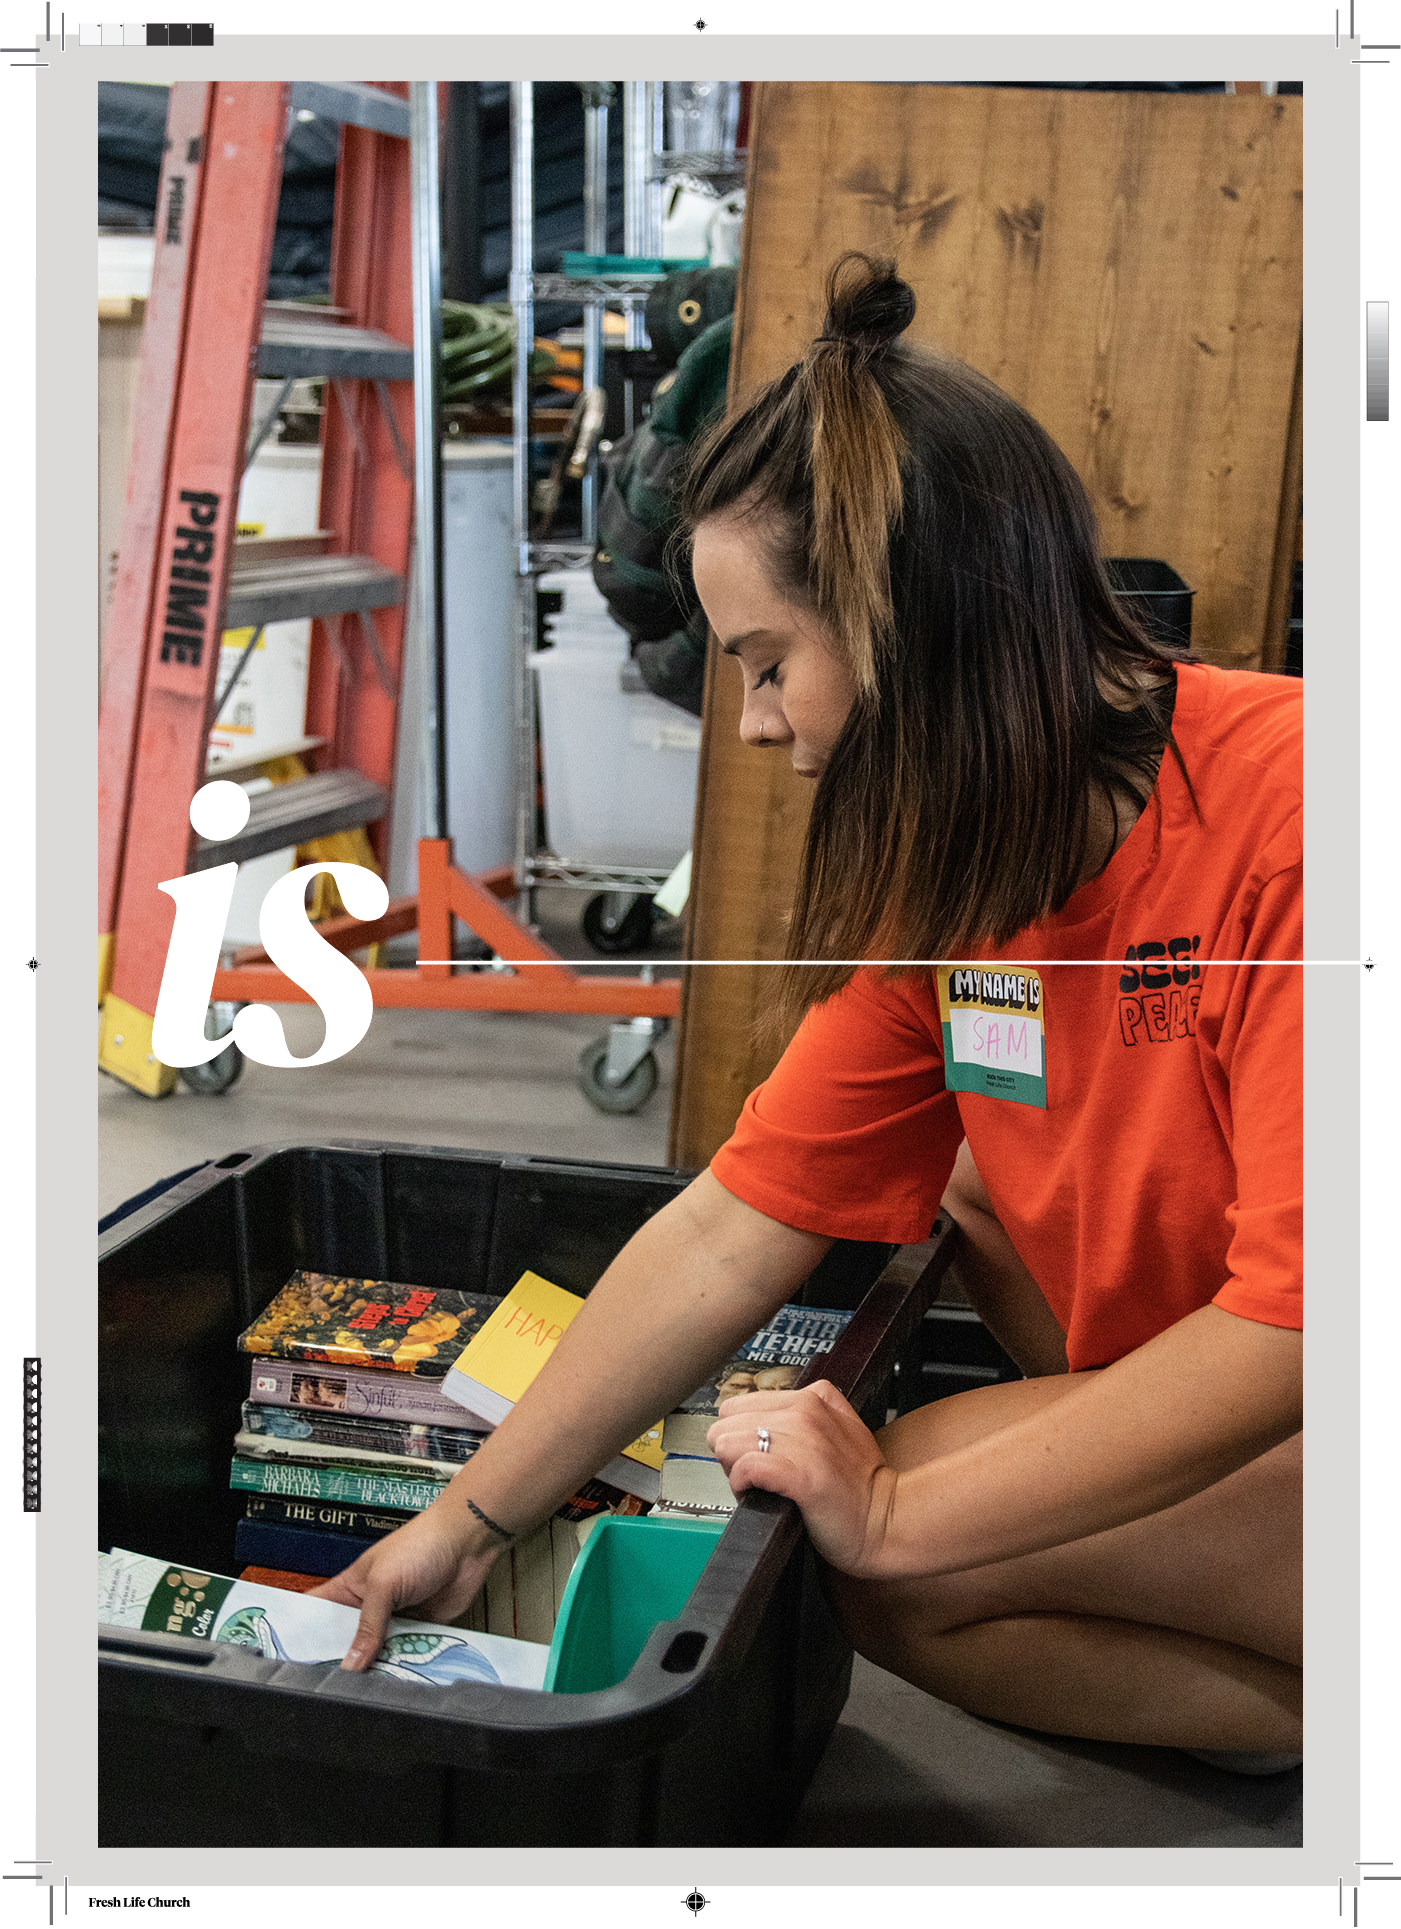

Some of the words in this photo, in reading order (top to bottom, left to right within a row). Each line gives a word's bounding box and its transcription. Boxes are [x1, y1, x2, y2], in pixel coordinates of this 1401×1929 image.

[160, 489, 219, 668] PRIME
[949, 969, 981, 1002] MY
[981, 971, 1025, 1010] NAME
[1026, 977, 1040, 1012] IS
[973, 1016, 1027, 1059] SAM
[747, 1351, 774, 1363] MEL
[348, 1381, 396, 1415] Sinful
[261, 1479, 320, 1498] MICHAELS
[264, 1465, 319, 1486] BARBARA
[356, 1477, 379, 1491] THE
[382, 1481, 431, 1497] MASTER
[284, 1503, 315, 1520] THE
[319, 1508, 358, 1527] GIFT
[192, 1609, 214, 1636] Color
